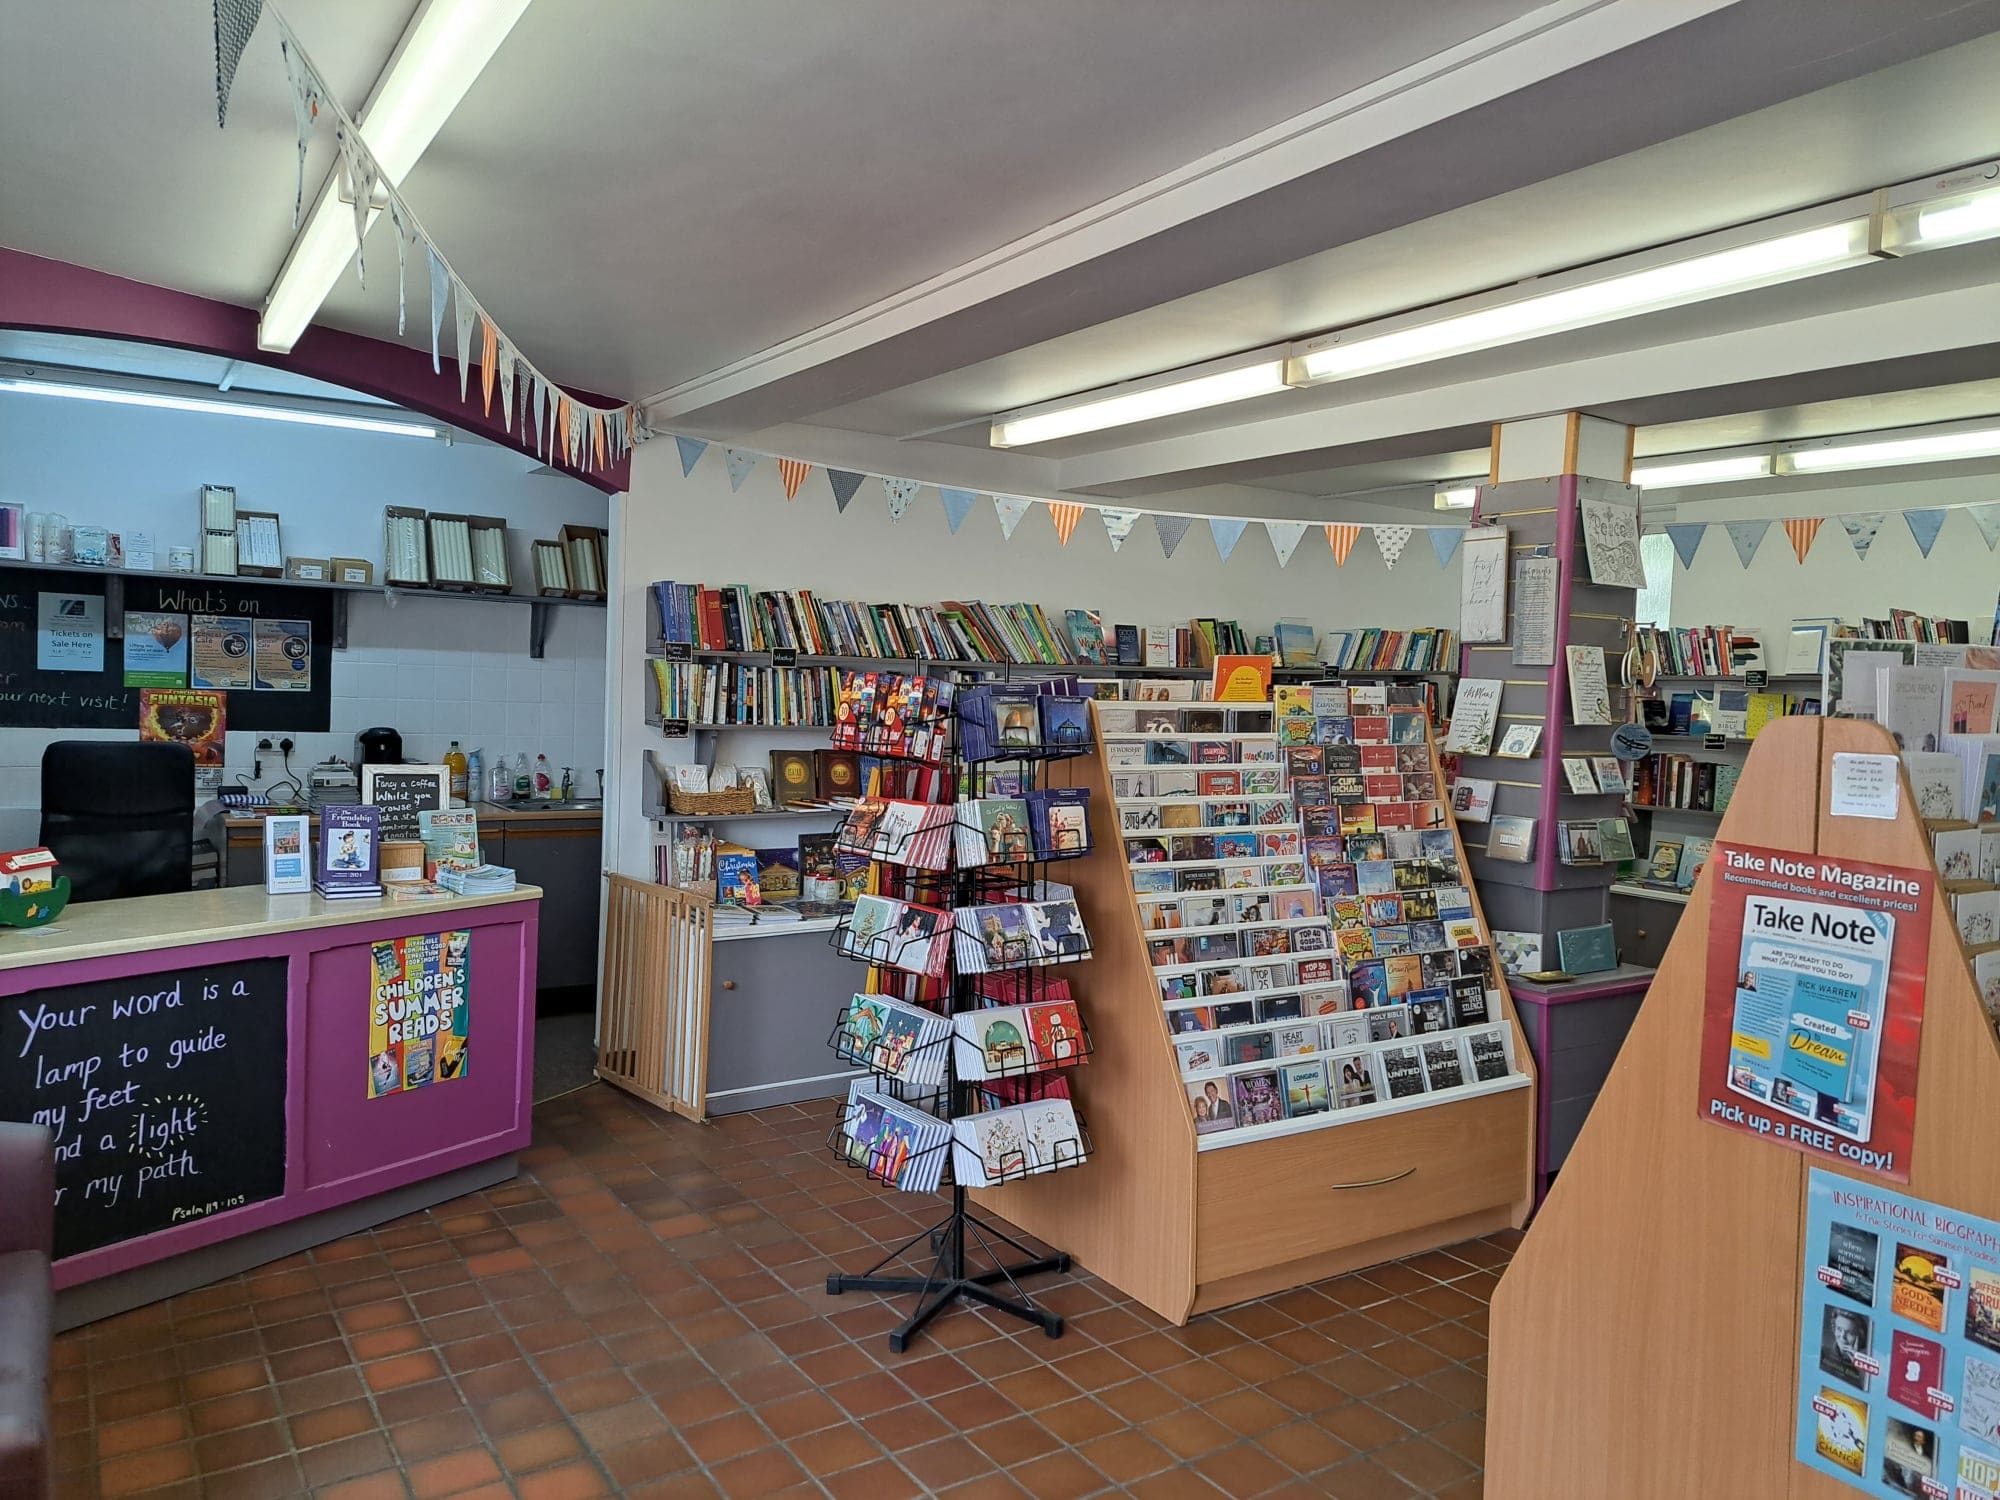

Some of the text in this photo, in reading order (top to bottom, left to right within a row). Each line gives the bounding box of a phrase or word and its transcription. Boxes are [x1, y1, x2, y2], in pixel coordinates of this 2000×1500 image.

[159, 588, 260, 614] What's on
[50, 629, 80, 638] Tickets
[51, 640, 92, 649] Sale Here
[28, 691, 71, 707] next
[80, 693, 128, 711] visit!
[149, 693, 219, 708] FUNTASIA
[840, 706, 849, 718] 30
[375, 775, 397, 790] Fancy
[411, 779, 438, 789] coffee
[1331, 784, 1363, 793] RICHARD
[1338, 777, 1357, 785] CLIFF
[376, 791, 433, 803] Whilst you
[331, 813, 373, 823] Friendship
[1124, 814, 1140, 830] 2019
[1351, 838, 1382, 849] SAMSON
[1724, 850, 1921, 897] Take Note Magazine
[1724, 872, 1918, 912] Recommended books and excellent prices!
[1753, 904, 1876, 945] Take Note
[1871, 912, 1887, 929] FREE
[430, 942, 447, 950] GOOD
[1761, 955, 1854, 980] WHAT YOU TO DO?
[1771, 949, 1784, 957] ARE
[1784, 952, 1798, 960] YOU
[1799, 955, 1822, 965] READY
[1832, 962, 1844, 970] DO
[1255, 969, 1268, 979] TOP
[1798, 980, 1858, 1000] RICK WARREN
[375, 986, 465, 1026] SUMMER
[18, 978, 250, 1058] Your word is a
[1370, 1010, 1404, 1022] HOLY BIBLE
[389, 1010, 453, 1045] READS
[1185, 1021, 1193, 1030] TOP
[1803, 1018, 1837, 1035] Created
[1282, 1031, 1304, 1042] HEART
[1789, 1028, 1845, 1062] Dream
[35, 1026, 227, 1090] lamp to guide
[1475, 1050, 1504, 1062] UNITED
[1388, 1067, 1420, 1079] UNITED
[1428, 1060, 1459, 1071] UNITED
[1293, 1072, 1319, 1082] LONGING
[32, 1081, 141, 1142] my feet
[54, 1107, 198, 1163] nd a light
[1710, 1099, 1893, 1171] Pick up a FREE copy!
[85, 1175, 123, 1208] my
[137, 1150, 200, 1199] path
[171, 1204, 204, 1222] Psalm
[1832, 1191, 1929, 1228] INSPIRATIONAL
[1864, 1214, 1882, 1226] True
[1884, 1220, 1913, 1237] Stories
[1913, 1231, 1926, 1241] for
[1928, 1234, 1962, 1251] Summer
[1901, 1287, 1933, 1306] GOD'S
[1895, 1296, 1938, 1319] NEEDLE
[1818, 1441, 1860, 1466] CHANCE
